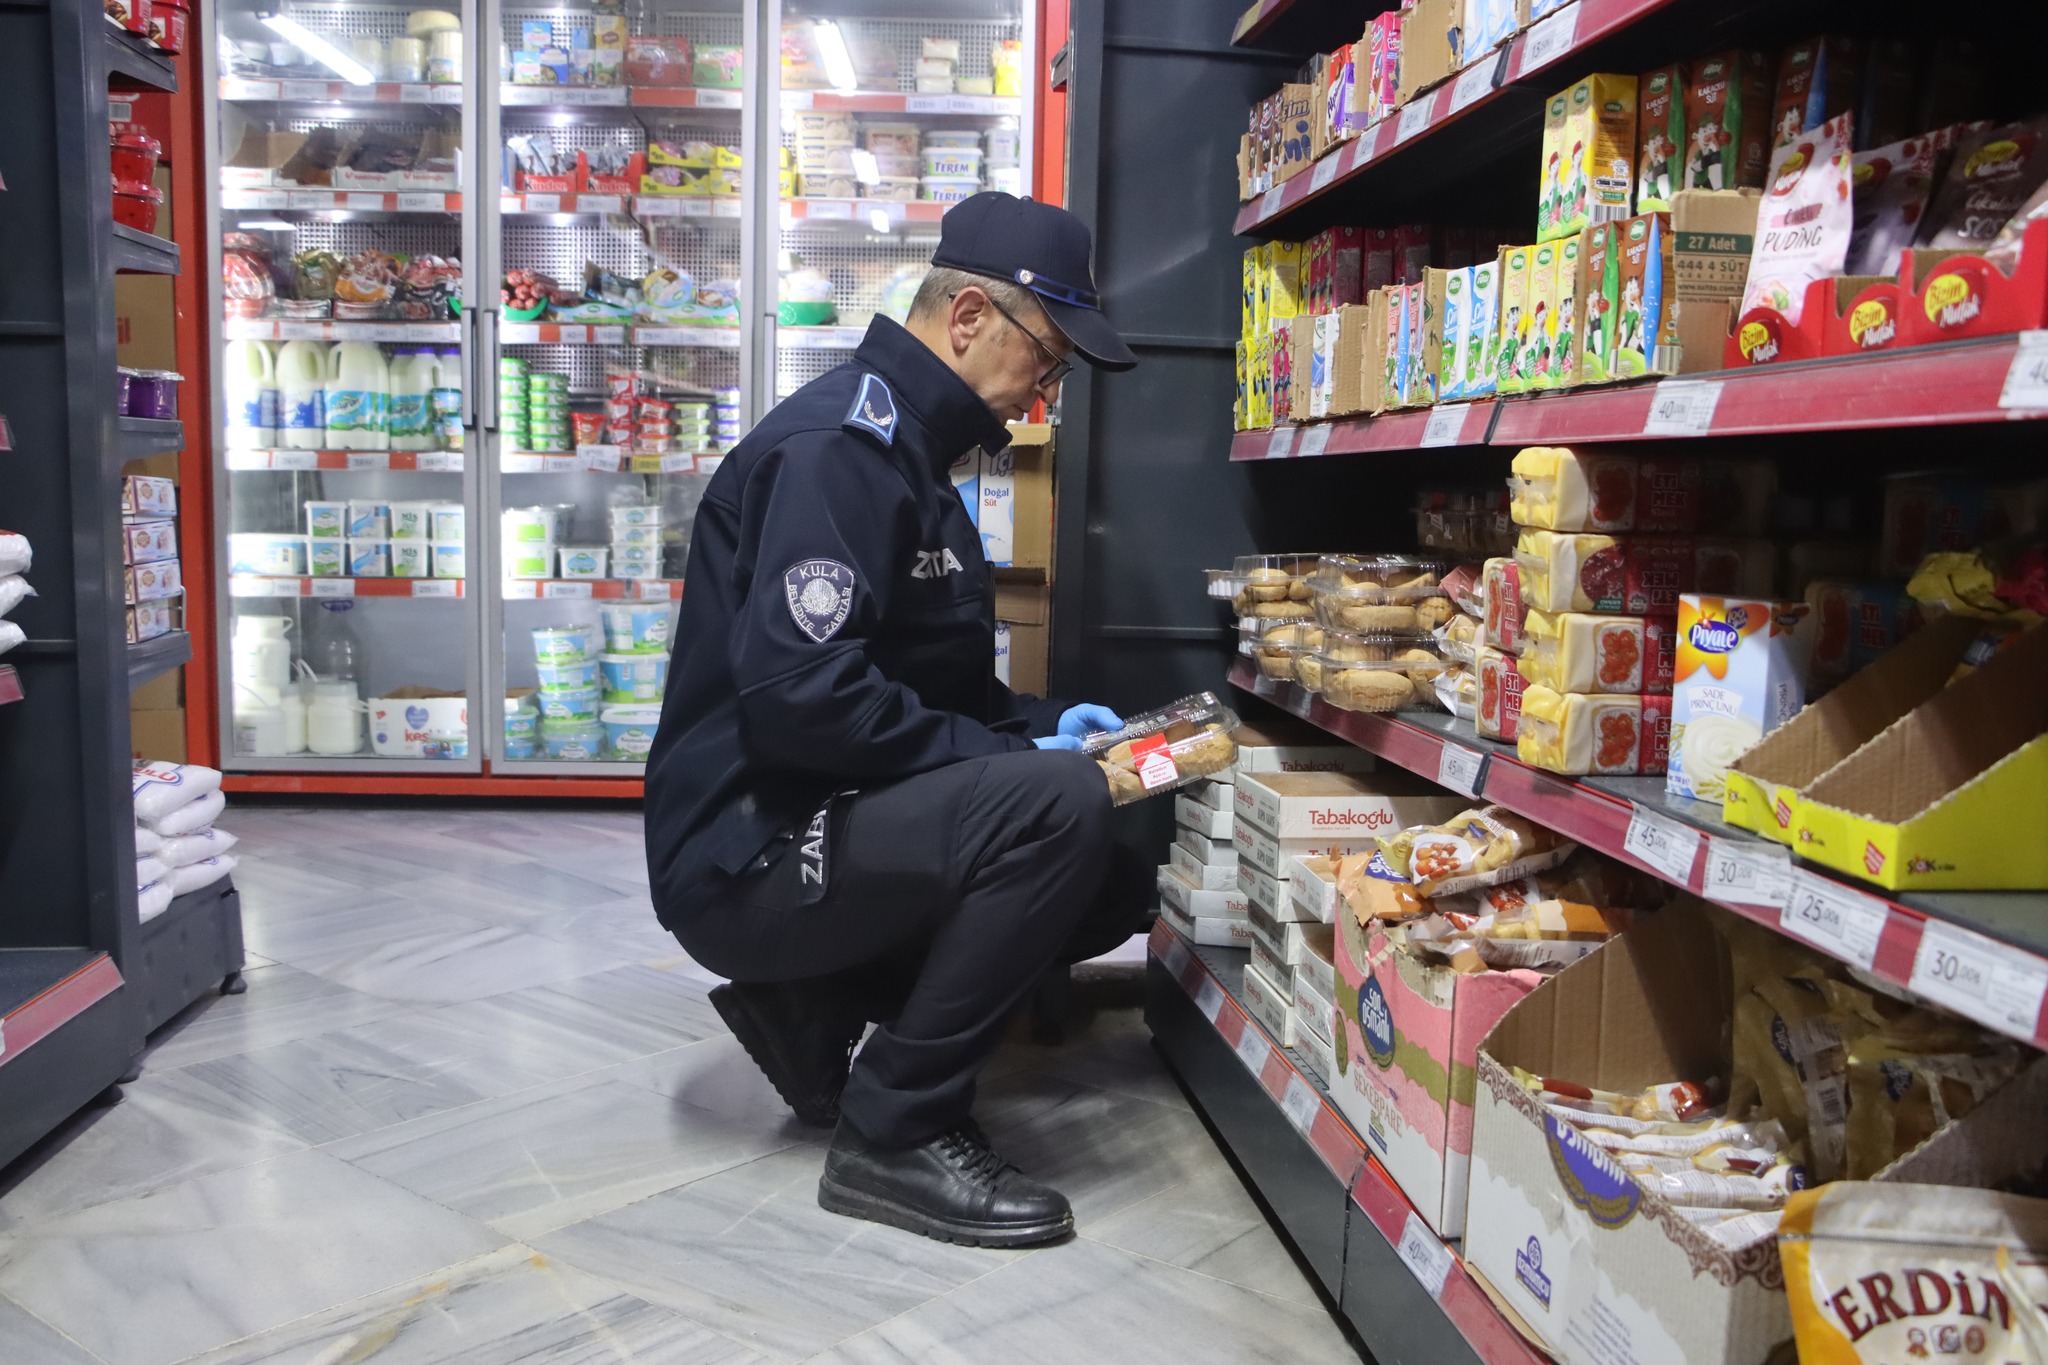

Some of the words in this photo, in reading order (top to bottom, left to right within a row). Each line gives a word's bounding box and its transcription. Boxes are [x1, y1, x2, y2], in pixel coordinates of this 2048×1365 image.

[934, 161, 969, 173] TEREM
[524, 178, 568, 193] Kinder
[587, 178, 631, 193] Kinder
[932, 190, 968, 201] TEREM
[1688, 235, 1704, 250] 27
[1707, 236, 1737, 251] Adet
[1761, 225, 1824, 252] PUDİNG
[1677, 258, 1703, 271] 444
[1707, 260, 1715, 272] 4
[1720, 258, 1745, 272] SÜT
[1928, 277, 1963, 311] Bizim
[1938, 292, 1981, 329] Mutfak
[1853, 307, 1883, 333] Bizim
[1741, 327, 1766, 350] Bizim
[1861, 318, 1896, 349] Mutfak
[1752, 340, 1780, 364] Mutfak
[983, 487, 1010, 499] Doğal
[983, 498, 997, 507] Süt
[800, 565, 840, 580] KULA
[788, 584, 816, 633] BELEDİYE
[822, 586, 852, 635] ZABITASI
[1691, 624, 1737, 649] Piyale
[994, 645, 1008, 657] ğal
[1658, 667, 1674, 678] Kla
[1702, 687, 1725, 701] SADE
[1690, 699, 1714, 713] PİRİNÇ
[1715, 702, 1737, 716] UNU
[1654, 751, 1669, 760] Kla
[1308, 808, 1394, 830] Tabakoğlu
[1353, 1068, 1402, 1139] ŞEKERPARE
